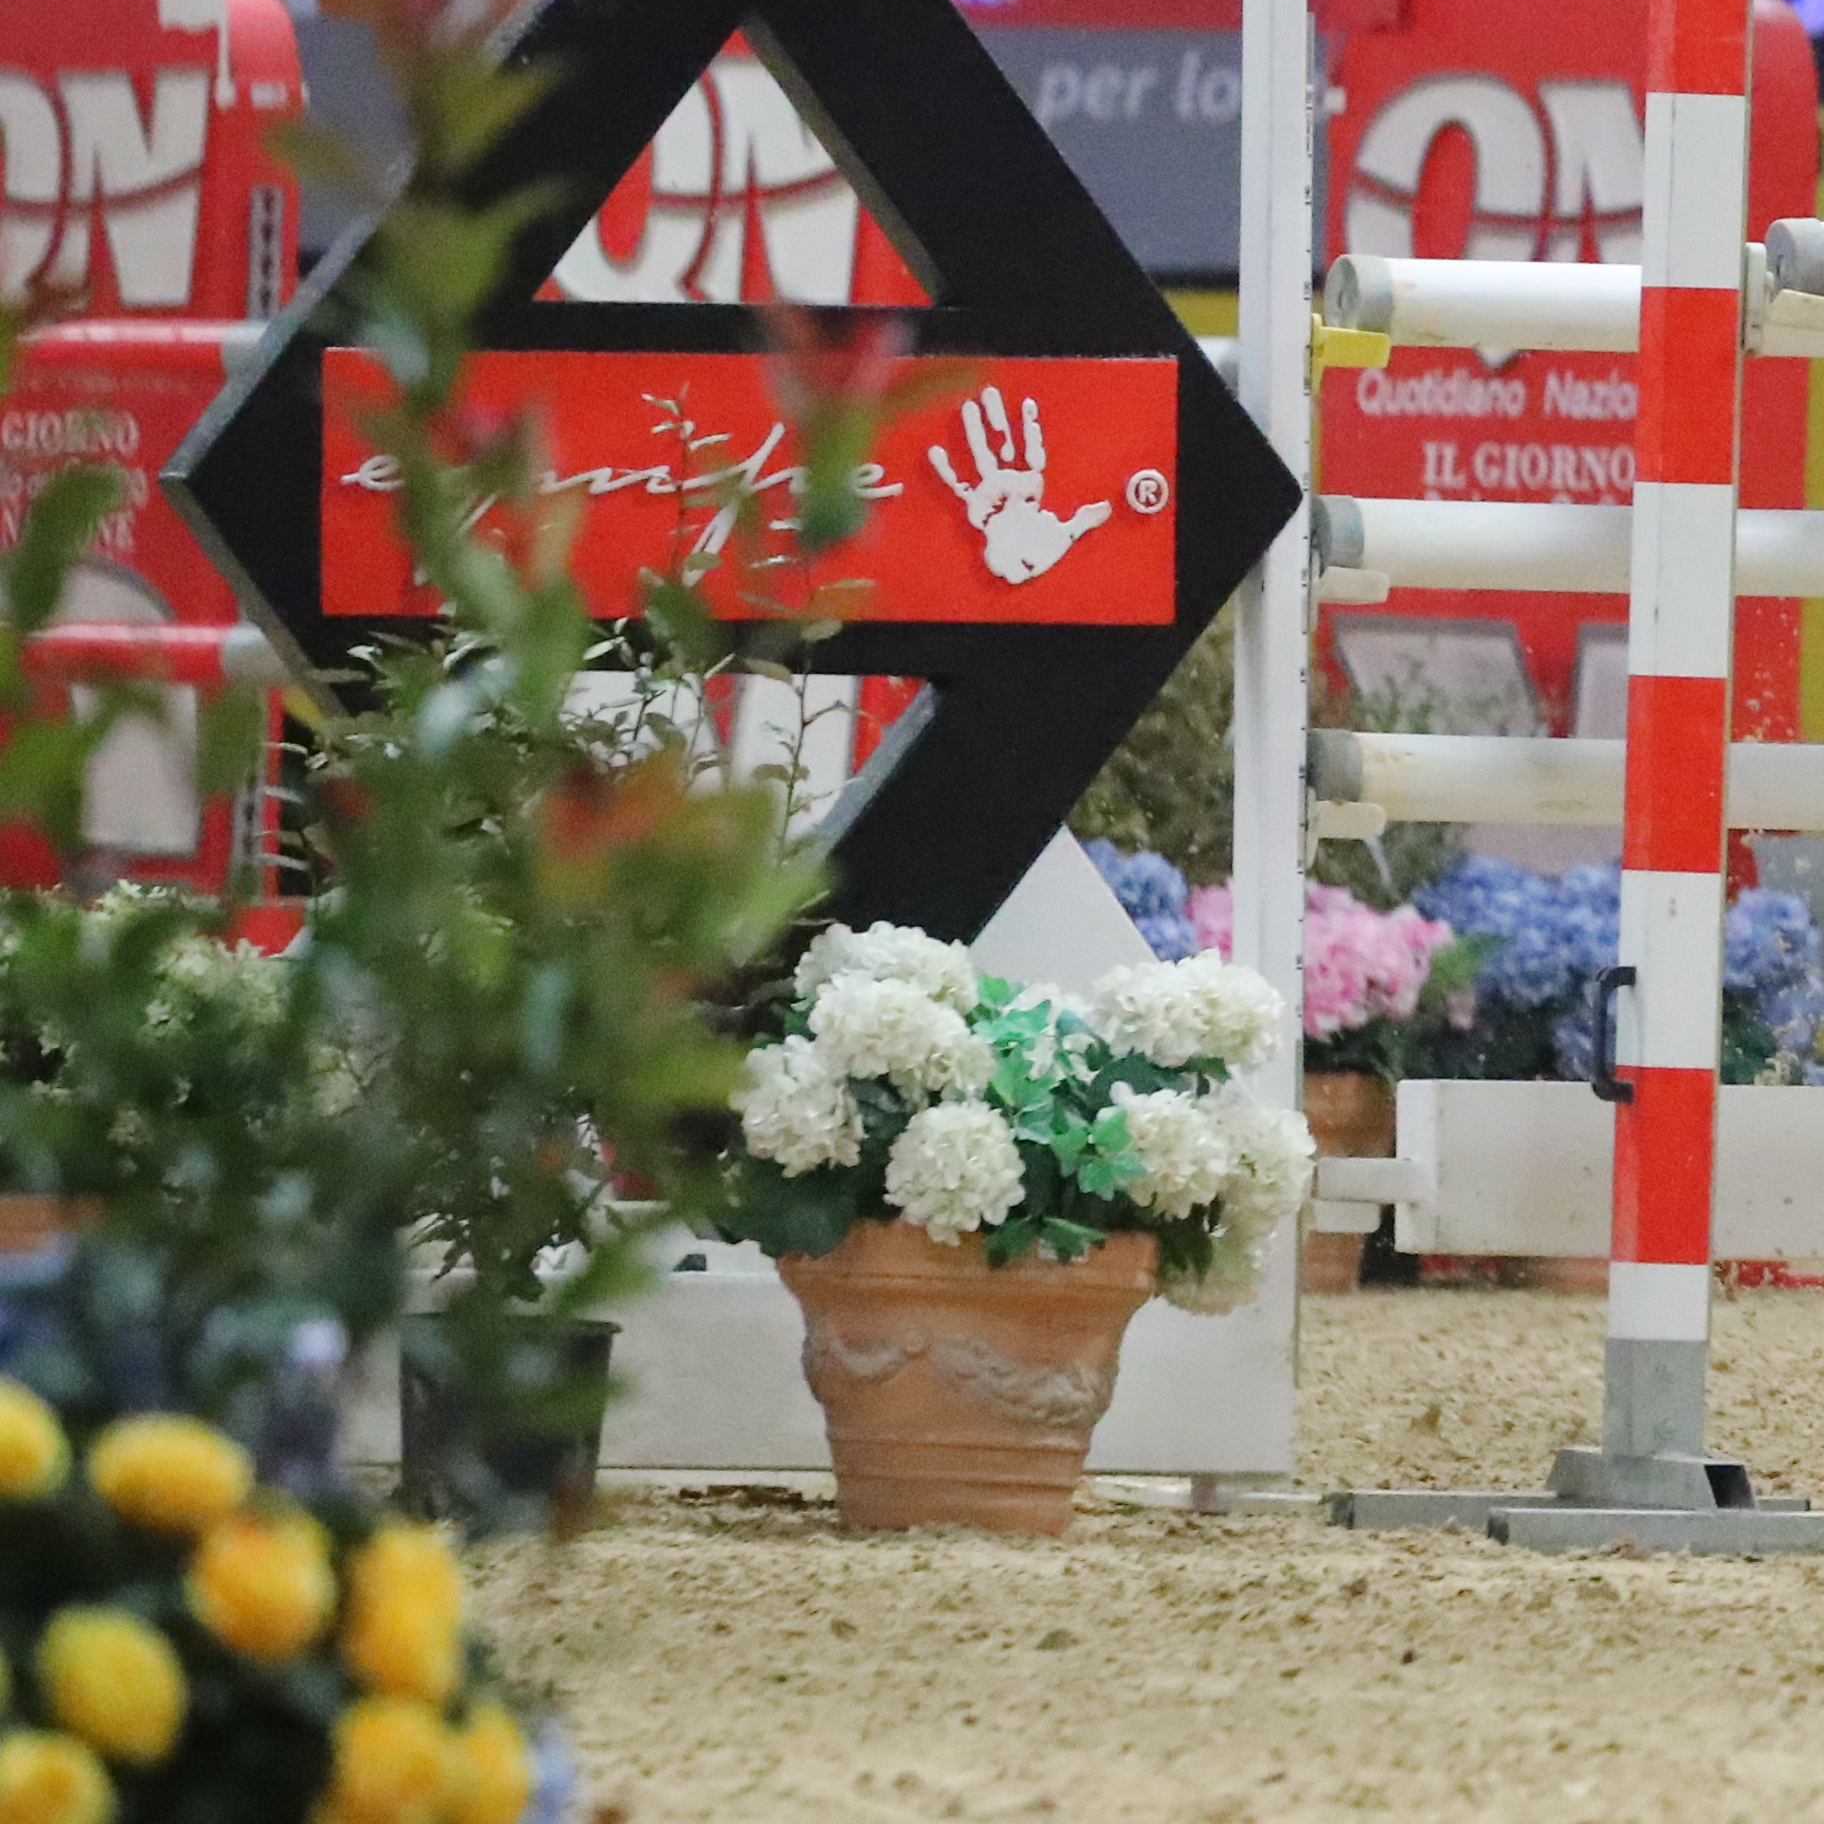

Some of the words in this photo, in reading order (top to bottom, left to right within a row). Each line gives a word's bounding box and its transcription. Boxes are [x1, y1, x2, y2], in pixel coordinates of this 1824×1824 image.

[1356, 366, 1528, 417] Quotidiano
[1423, 440, 1468, 489] IL
[1472, 441, 1637, 491] GIORNO
